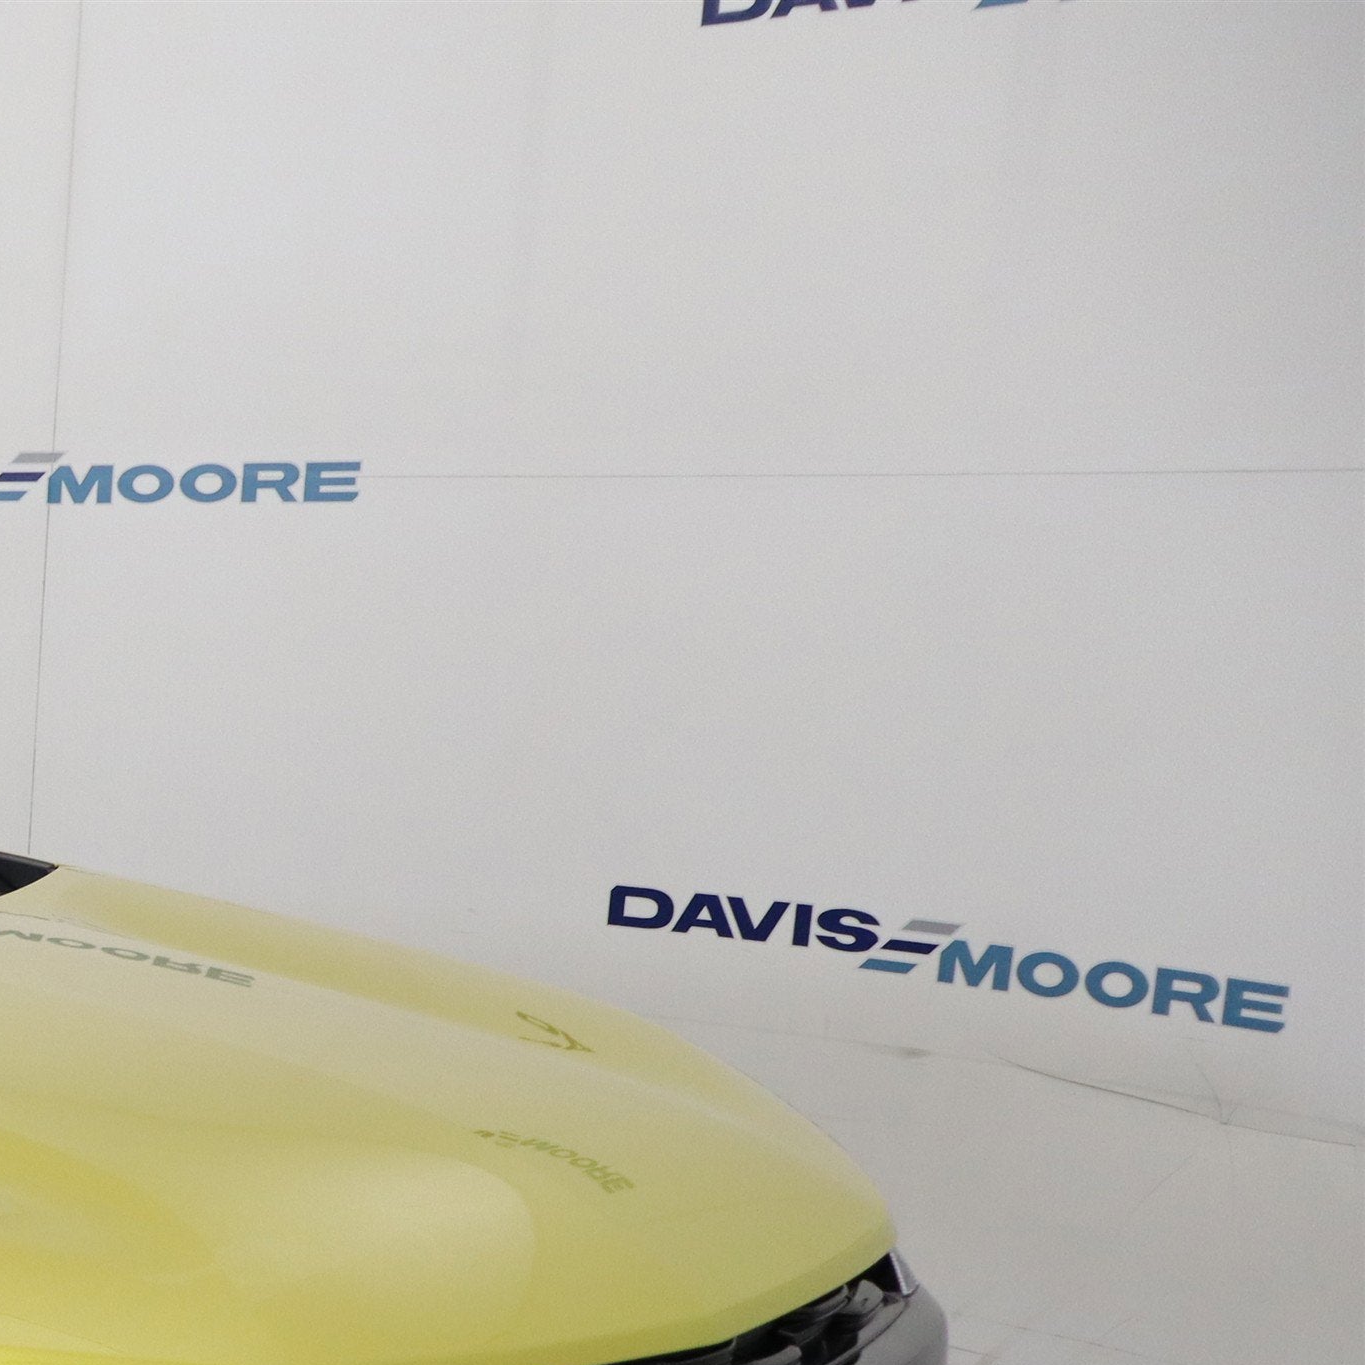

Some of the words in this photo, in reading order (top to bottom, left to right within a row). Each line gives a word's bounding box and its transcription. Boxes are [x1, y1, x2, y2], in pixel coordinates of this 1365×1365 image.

[45, 461, 361, 504] MOORE
[607, 885, 878, 952] DAVIS
[937, 940, 1290, 1033] MOORE
